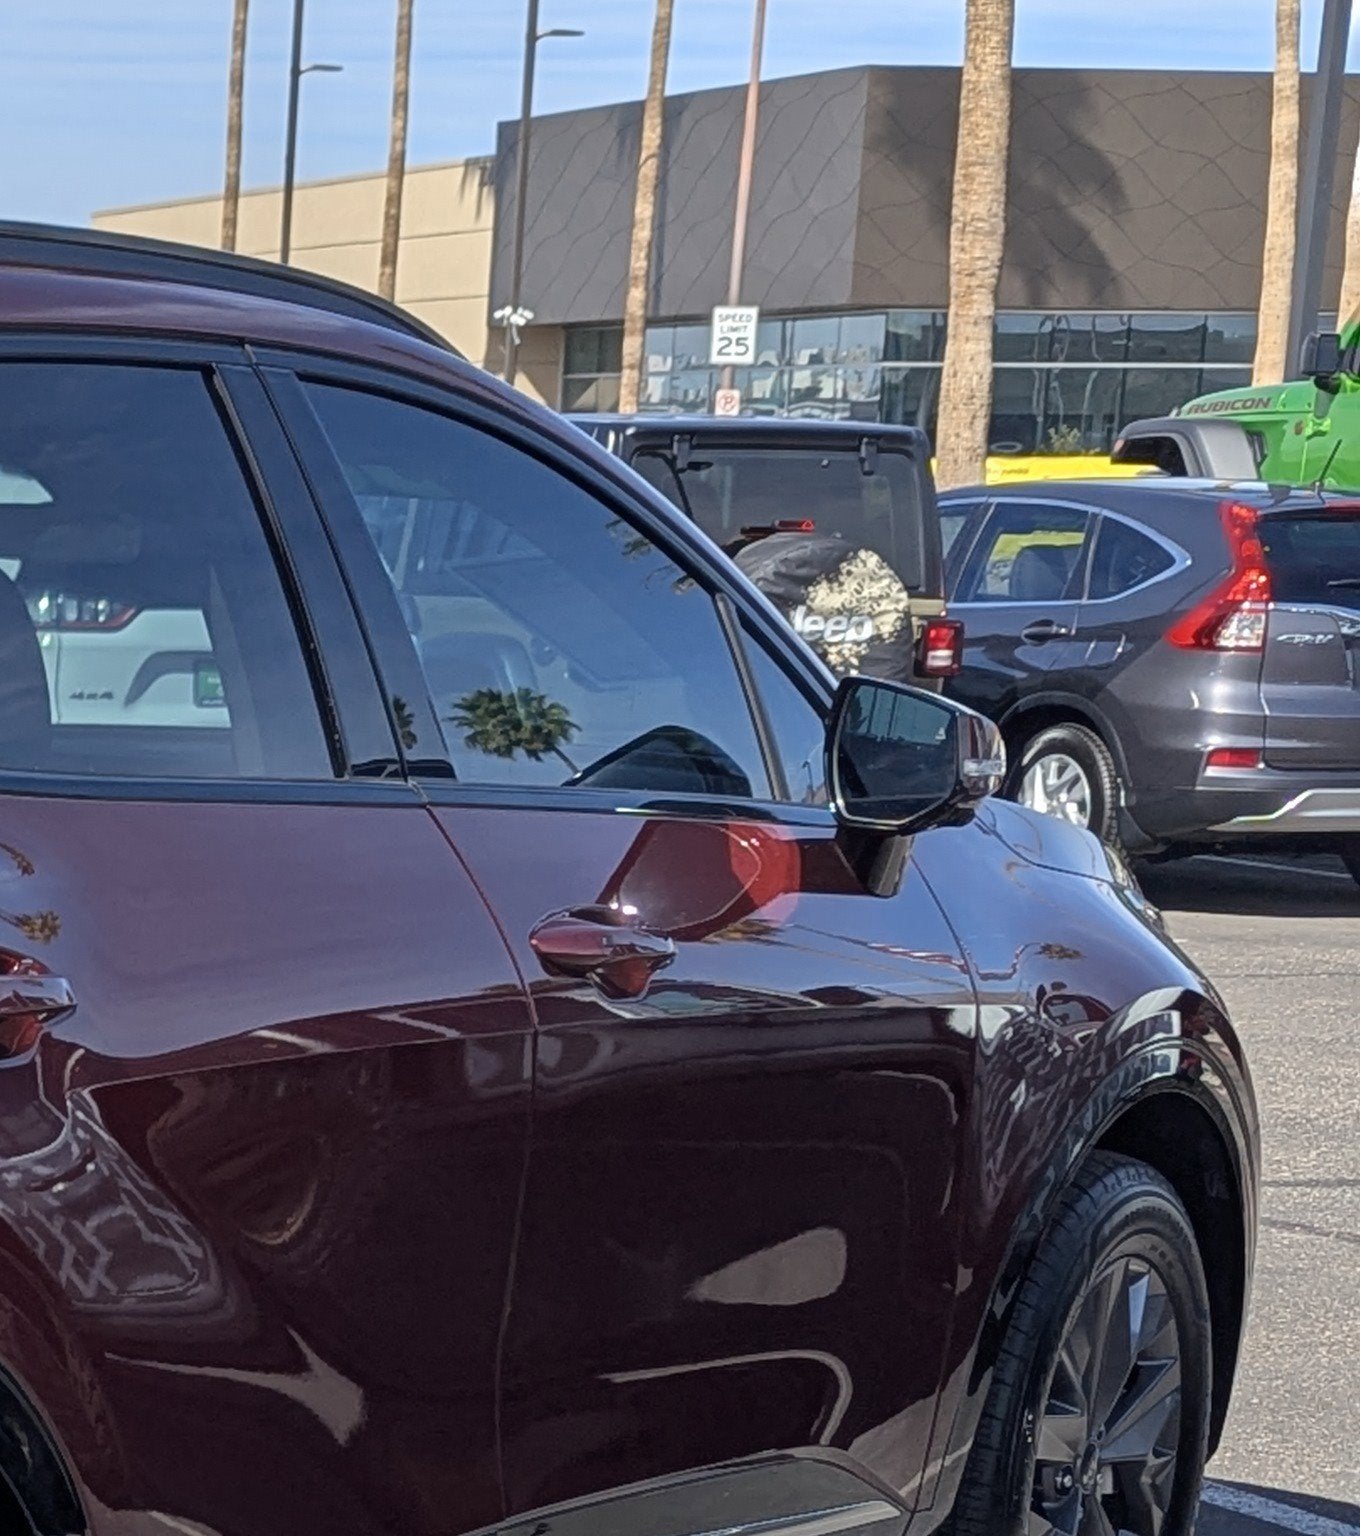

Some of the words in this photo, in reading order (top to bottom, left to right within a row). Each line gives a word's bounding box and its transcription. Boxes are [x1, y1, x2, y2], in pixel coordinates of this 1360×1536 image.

[717, 313, 754, 323] SPEED
[720, 325, 748, 334] LIMIT
[716, 336, 750, 356] 25
[1188, 397, 1270, 414] RUBICON
